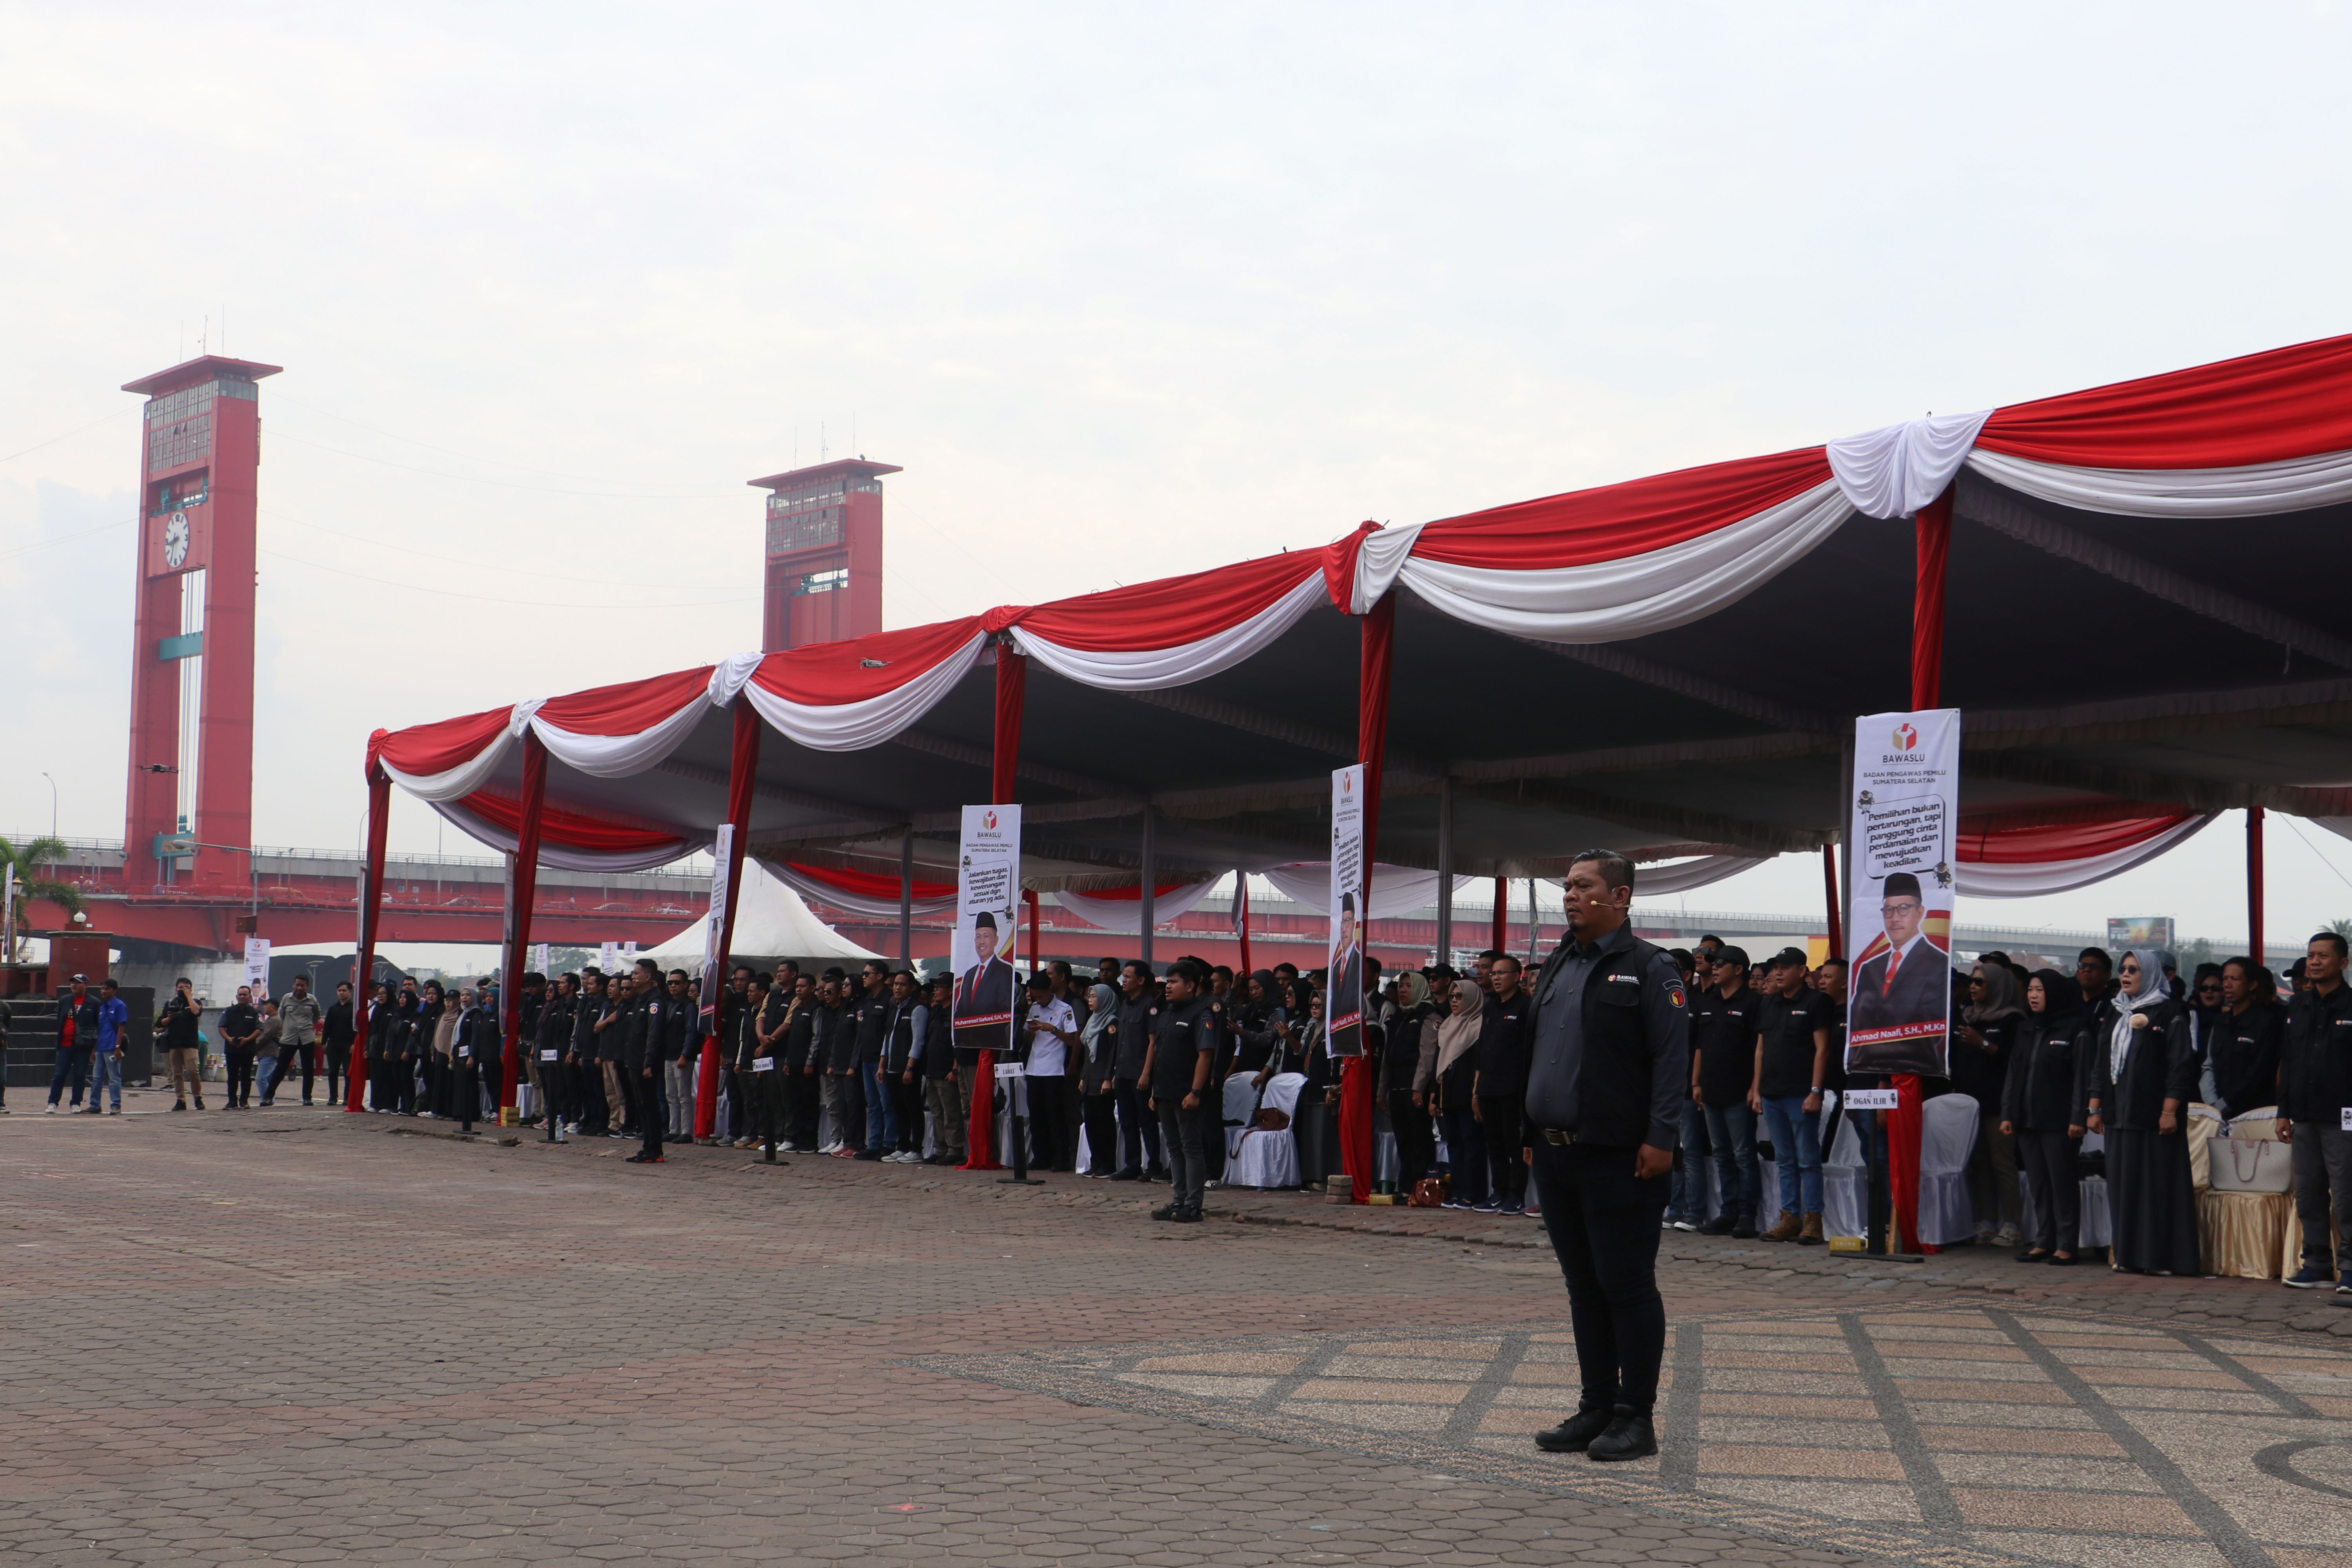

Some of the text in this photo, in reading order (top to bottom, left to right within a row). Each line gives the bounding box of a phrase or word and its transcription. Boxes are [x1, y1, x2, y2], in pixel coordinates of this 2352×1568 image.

[1883, 753, 1925, 763] BAWASLU
[1868, 803, 1940, 822] Pemilihan bukan
[1866, 811, 1942, 833] pertarungan, tapi
[1870, 824, 1937, 843] panggung cinta
[1869, 833, 1938, 853] perdamaian dan
[1875, 844, 1931, 860] mewujudkan
[1883, 857, 1922, 869] keadilan.
[992, 867, 1008, 876] tugas,
[969, 876, 995, 884] kewajiban
[970, 881, 1005, 891] kewenangan
[1851, 1023, 1945, 1043] Ahmad Naafi, S.H., M.Kn
